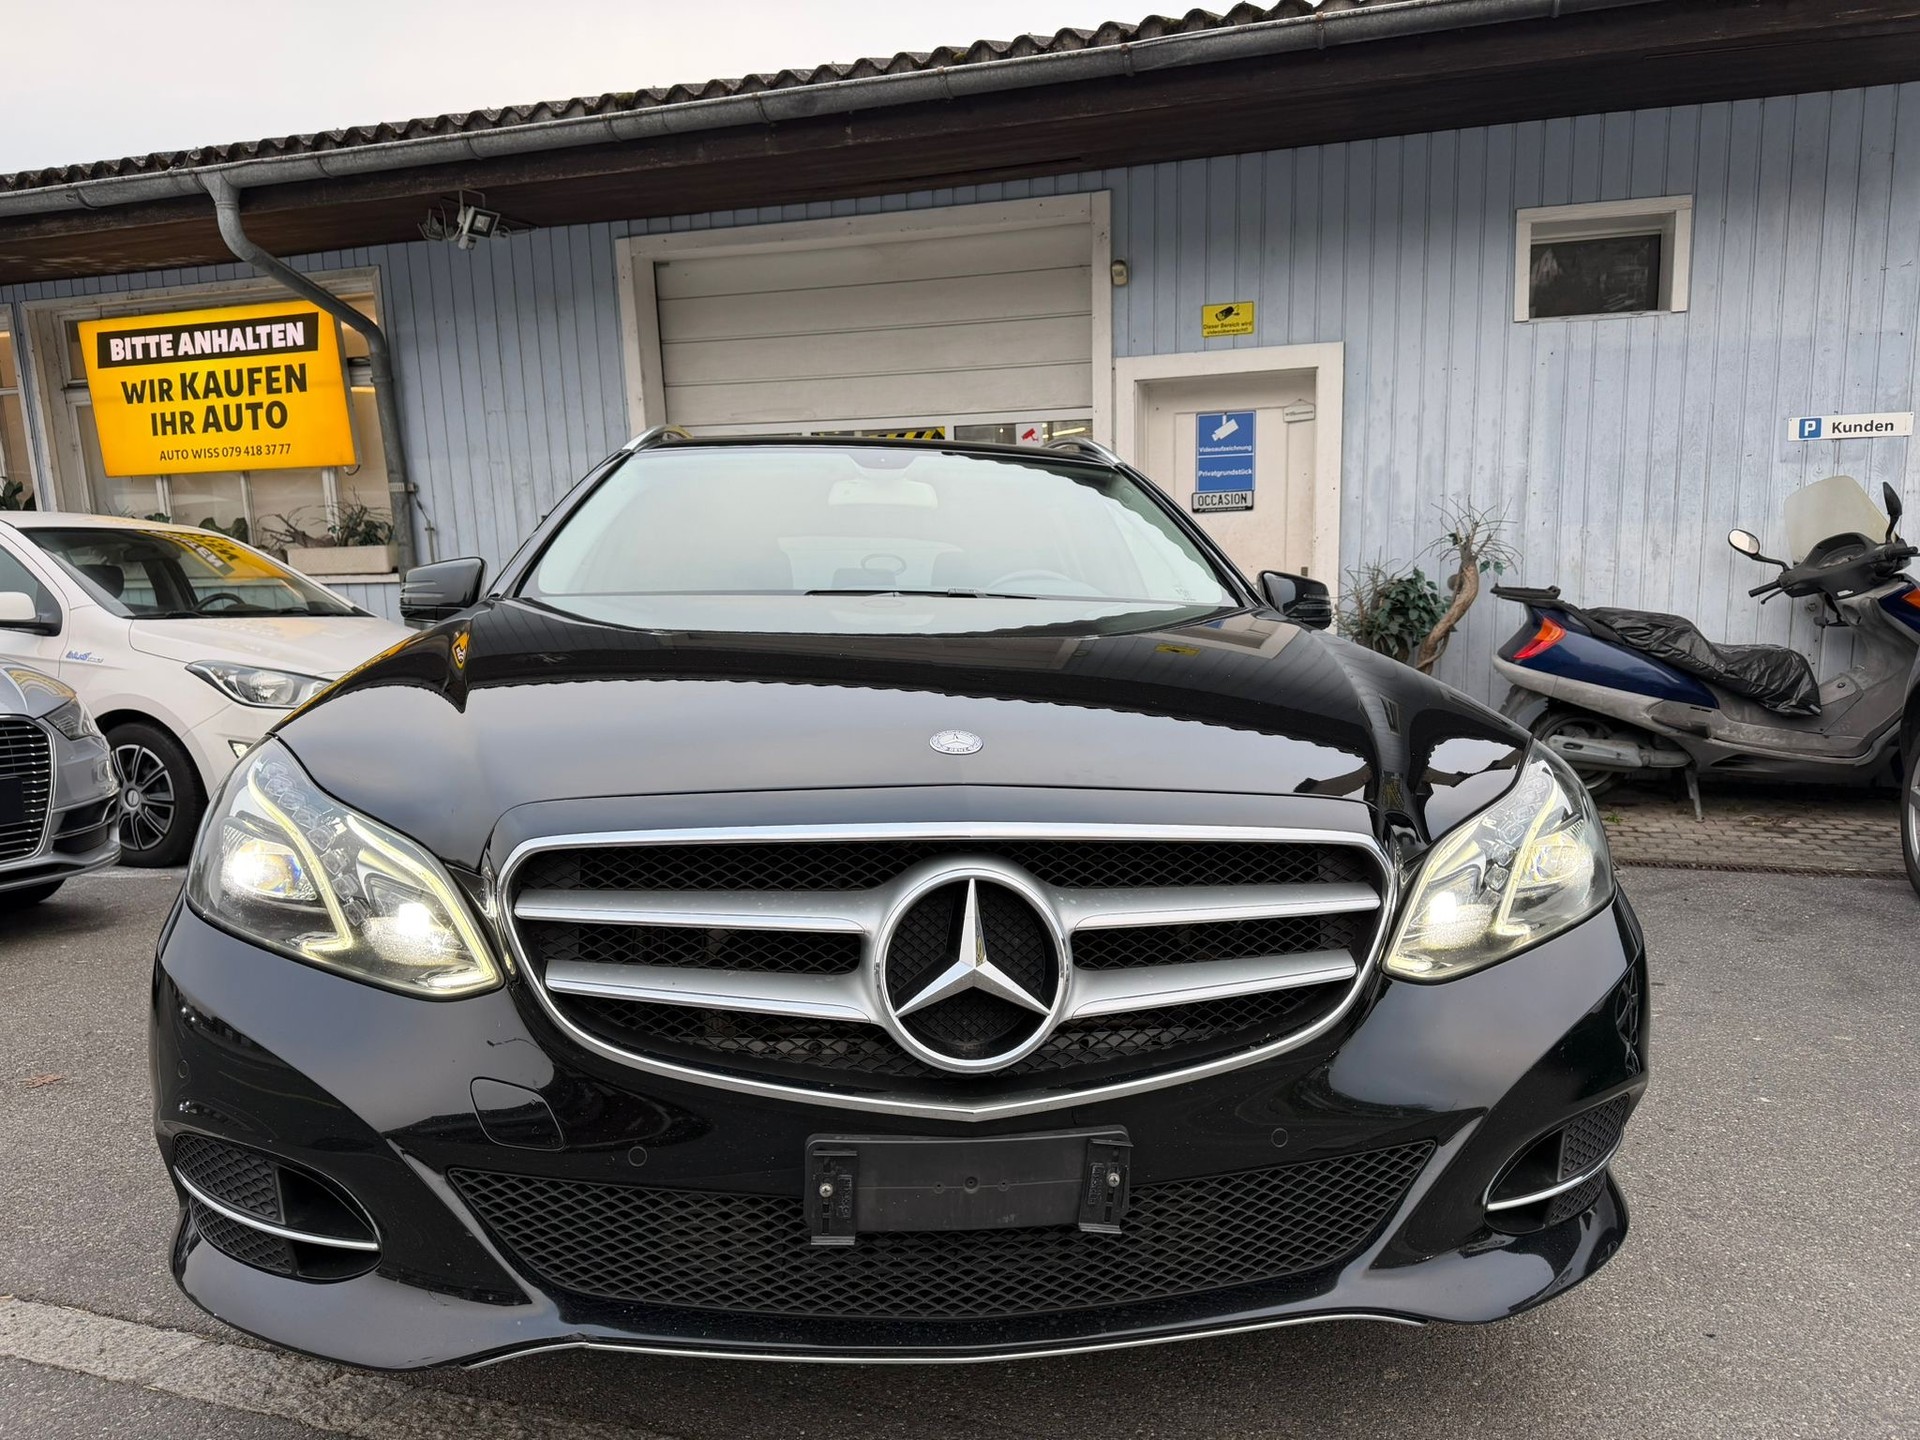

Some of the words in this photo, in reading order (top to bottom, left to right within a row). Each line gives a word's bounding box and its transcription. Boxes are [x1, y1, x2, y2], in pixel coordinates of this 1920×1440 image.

[109, 335, 174, 362] BITTE
[178, 321, 305, 356] ANHALTEN
[121, 377, 174, 405] WIR
[180, 363, 307, 401] KAUFEN
[151, 410, 195, 436] IHR
[202, 400, 288, 434] AUTO
[1804, 421, 1817, 436] P
[1832, 420, 1894, 433] Kunden
[159, 449, 189, 461] AUTO
[191, 447, 220, 459] WISS
[222, 446, 242, 457] 079
[243, 445, 263, 456] 418
[1198, 468, 1252, 477] Privatgrundstück
[1198, 493, 1247, 506] OCCASION
